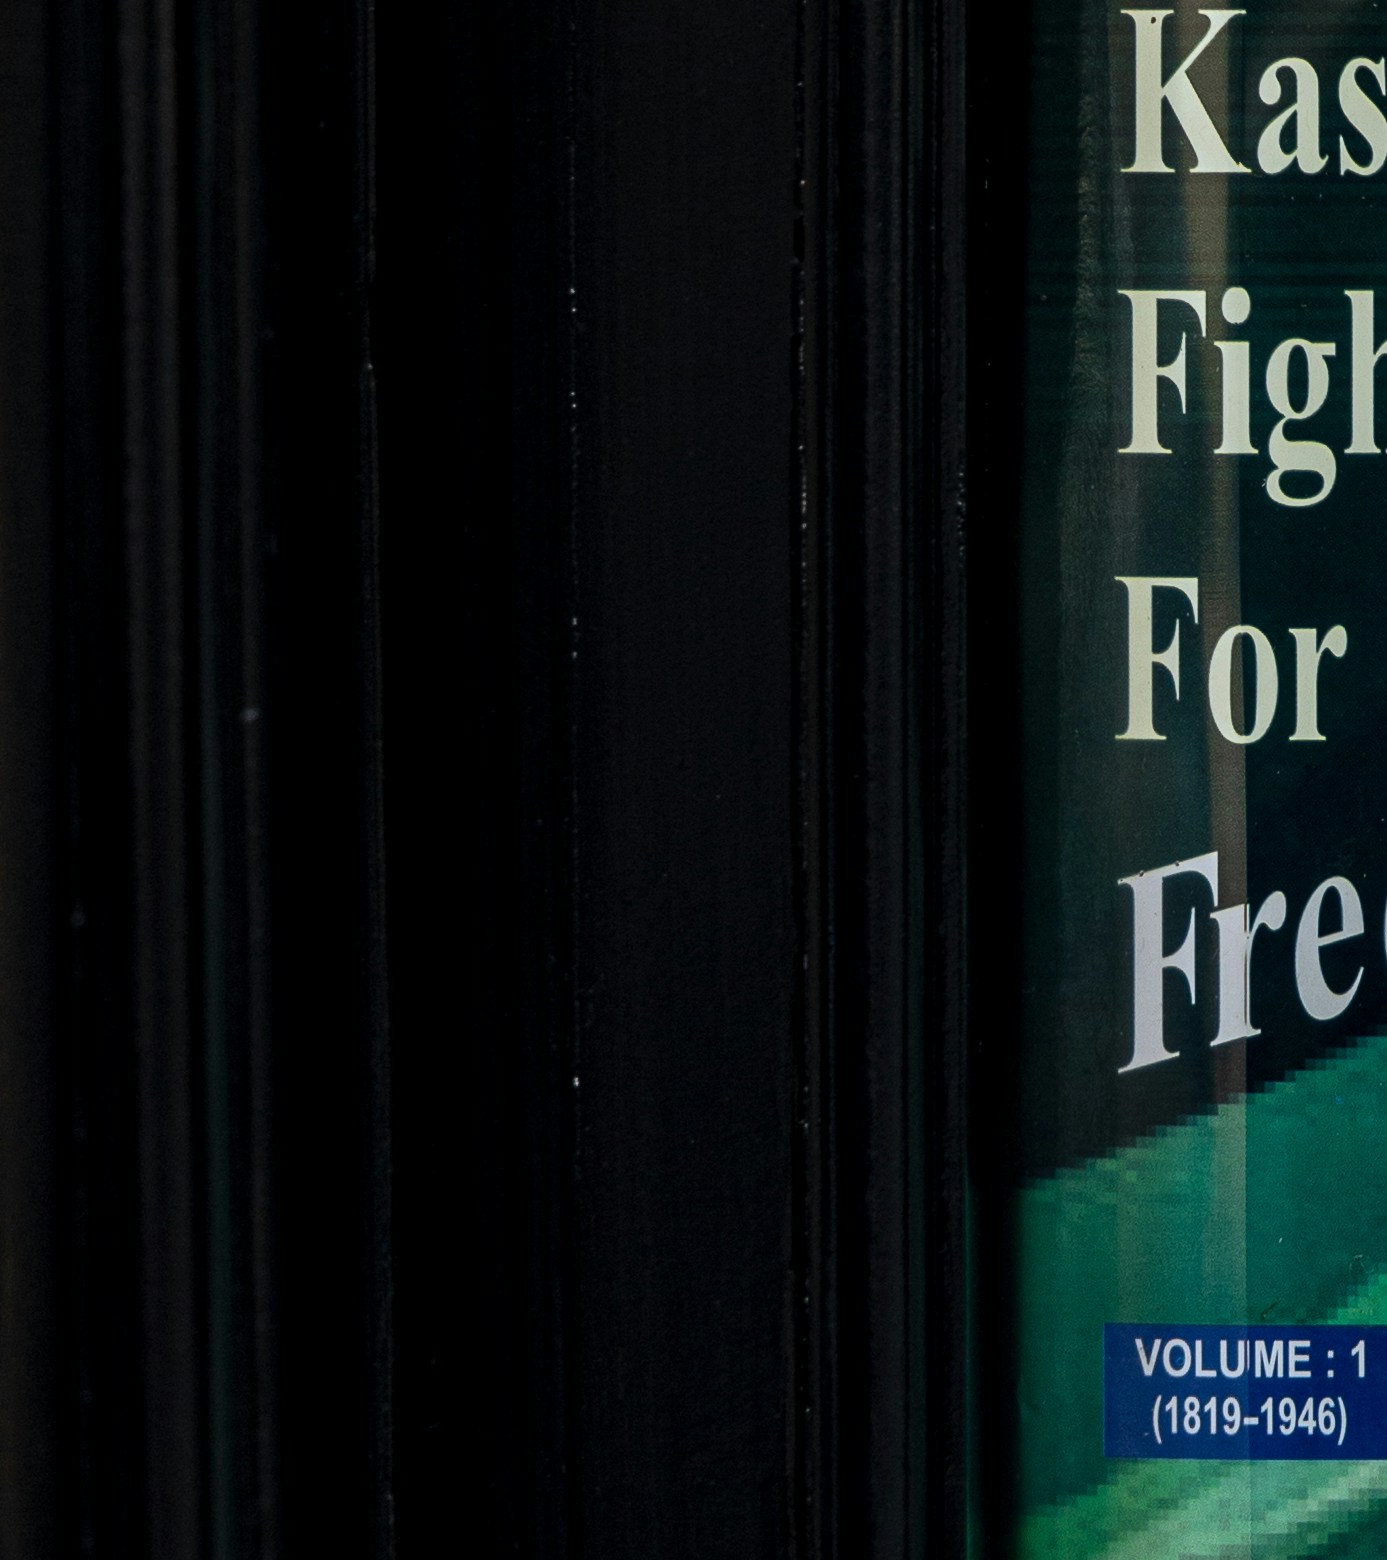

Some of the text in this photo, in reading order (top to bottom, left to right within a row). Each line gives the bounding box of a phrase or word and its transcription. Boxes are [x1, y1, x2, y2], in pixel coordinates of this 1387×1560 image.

[1113, 576, 1348, 743] For
[1351, 1339, 1366, 1379] 1
[1152, 1394, 1348, 1446] (1819-1946)
